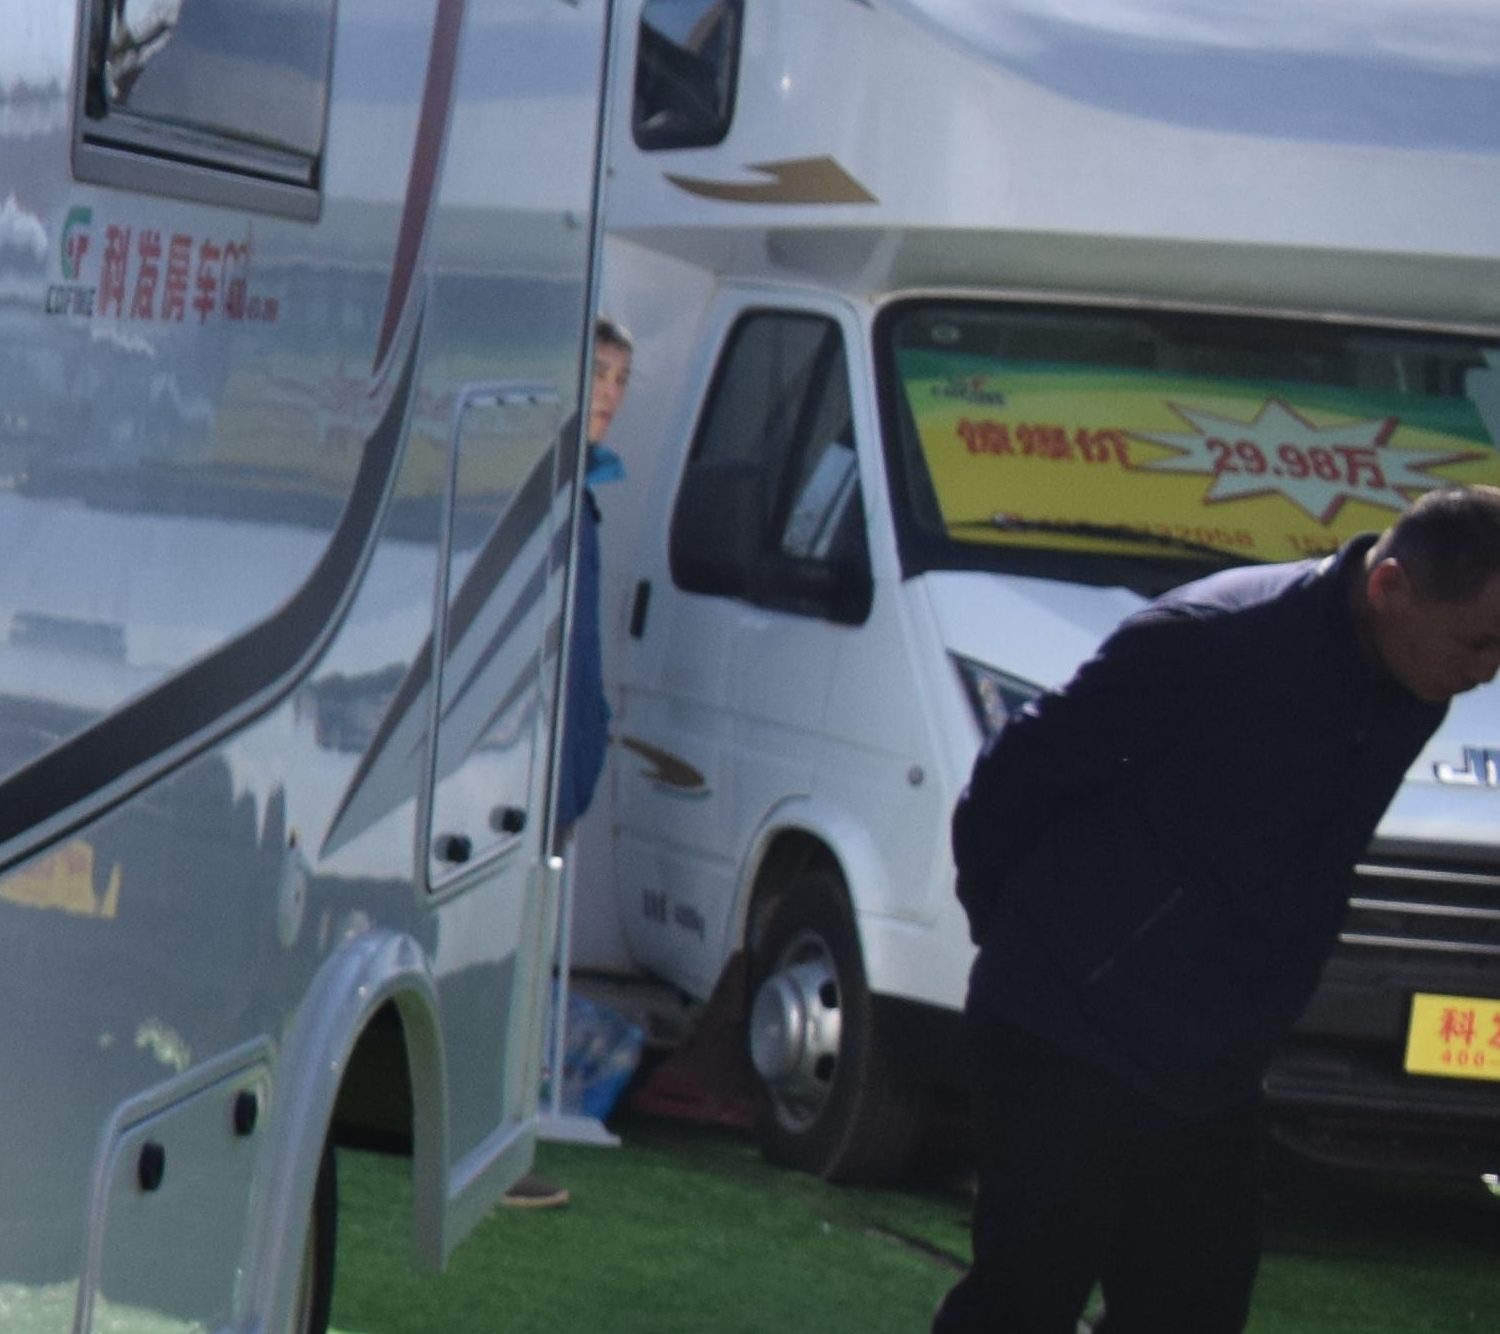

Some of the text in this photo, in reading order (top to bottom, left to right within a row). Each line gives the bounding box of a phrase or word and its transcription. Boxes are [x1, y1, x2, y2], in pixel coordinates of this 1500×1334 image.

[957, 415, 1389, 492] 惊爆价 29.98万
